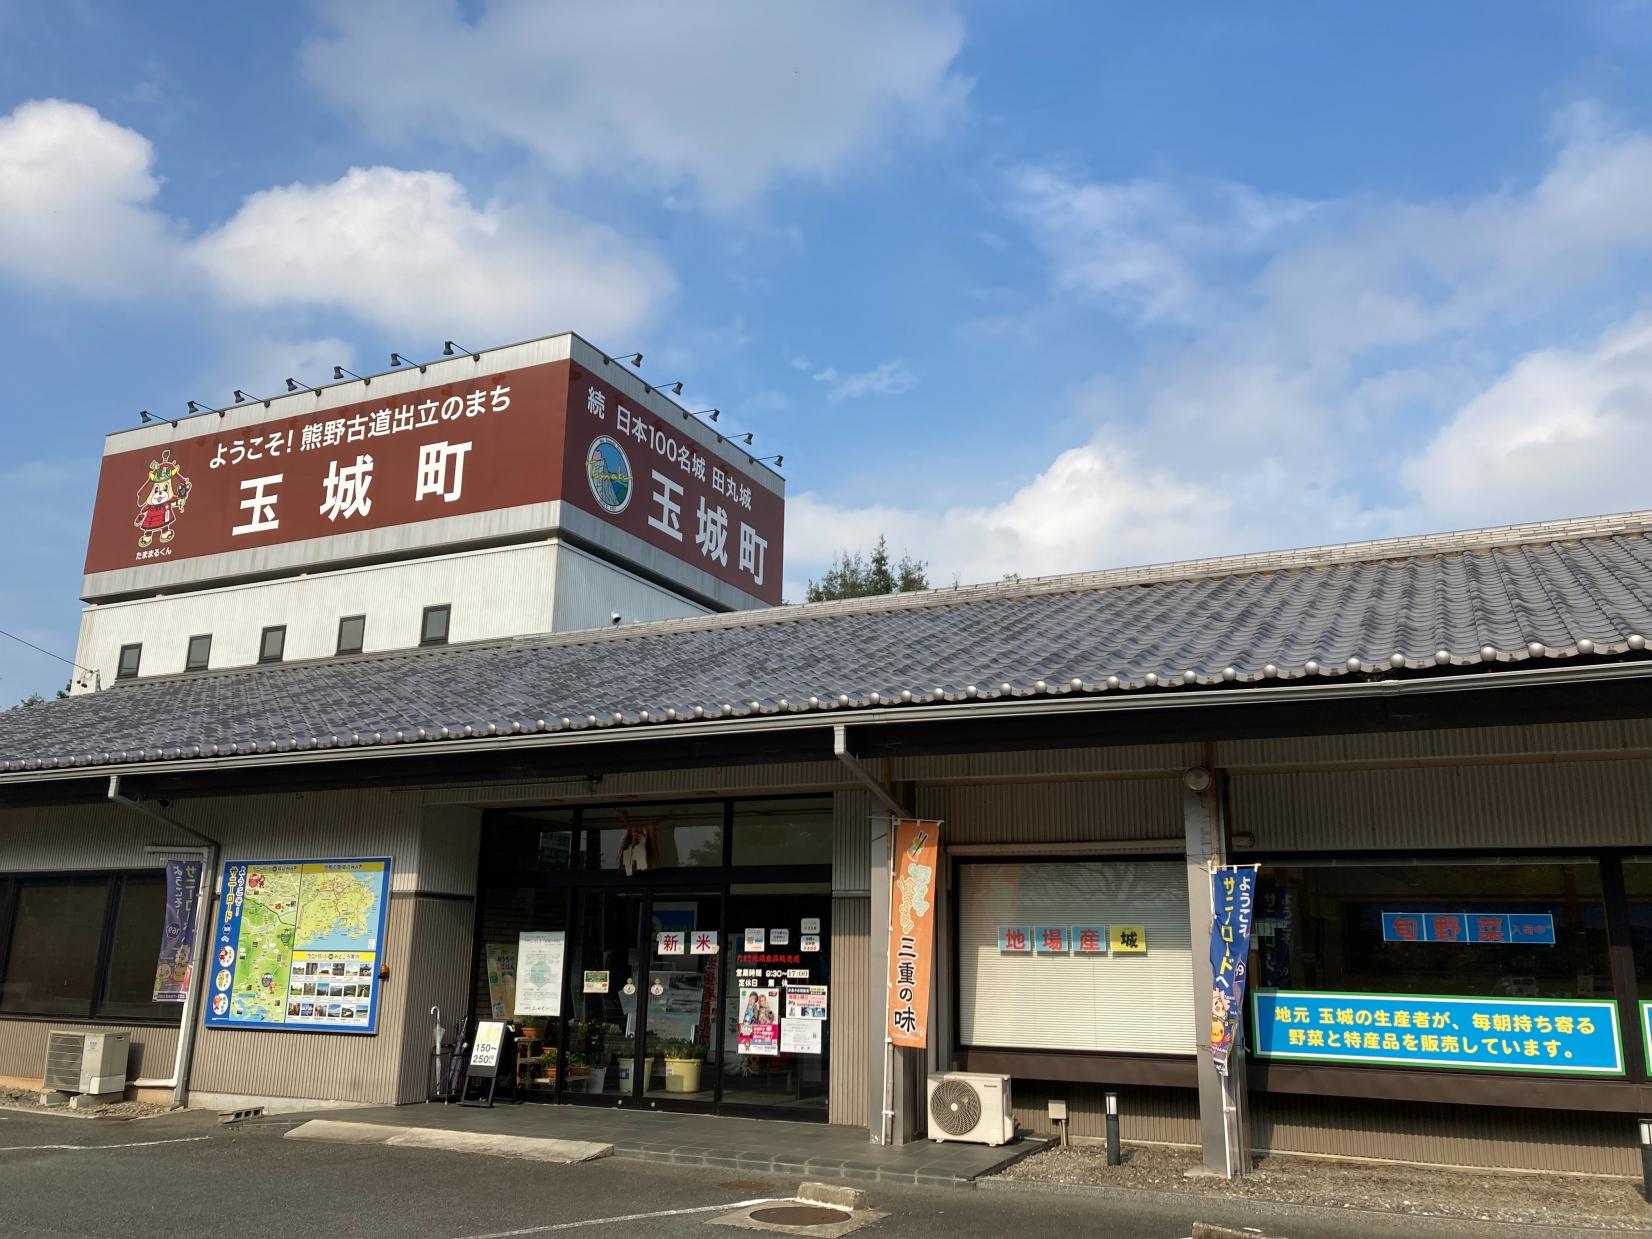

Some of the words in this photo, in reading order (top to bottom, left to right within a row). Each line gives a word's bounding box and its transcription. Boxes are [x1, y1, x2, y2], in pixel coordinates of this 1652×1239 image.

[300, 385, 512, 451] 熊野古道出立のまち
[587, 386, 605, 420] 続
[616, 404, 706, 483] 日本100名城
[712, 466, 752, 511] 田丸城
[647, 469, 768, 586] 玉城町
[1005, 927, 1100, 951] 地場産
[1119, 930, 1139, 949] 城
[1392, 915, 1505, 943] 旬野菜
[663, 933, 711, 952] 新米
[736, 968, 763, 978] 営業時間
[738, 979, 758, 987] 定休日
[893, 936, 918, 1034] 三重の味
[1274, 1006, 1310, 1023] 地元
[1288, 1028, 1574, 1059] 野菜と特産品を販売しています。
